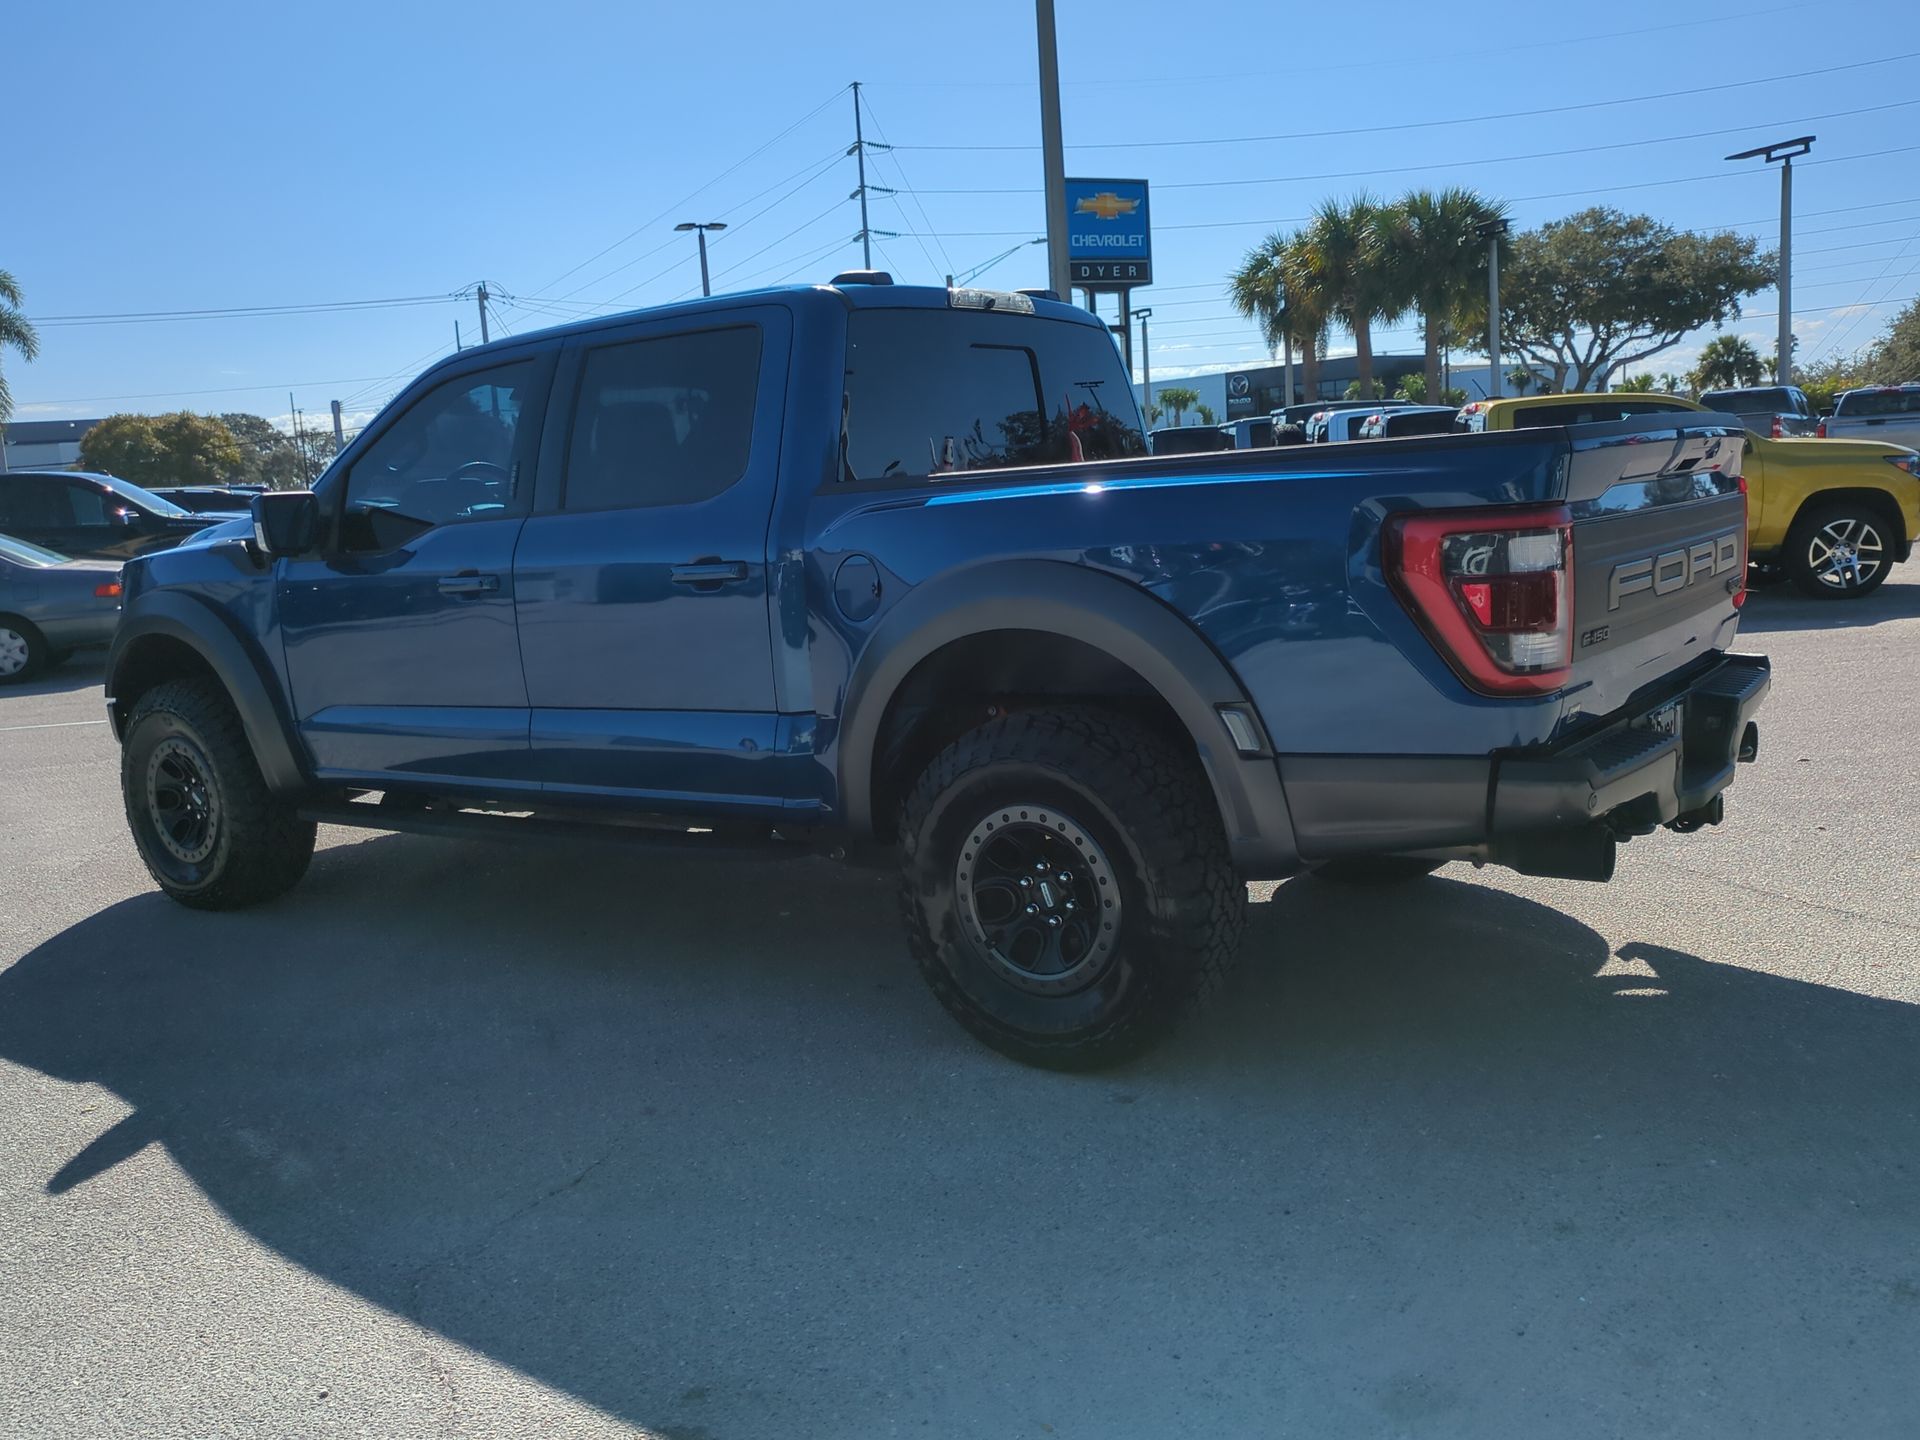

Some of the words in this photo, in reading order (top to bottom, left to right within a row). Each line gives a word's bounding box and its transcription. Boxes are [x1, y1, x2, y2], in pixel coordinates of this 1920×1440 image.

[1071, 234, 1144, 247] CHEVROLET
[1081, 265, 1137, 277] DYER
[1608, 533, 1738, 612] FORD
